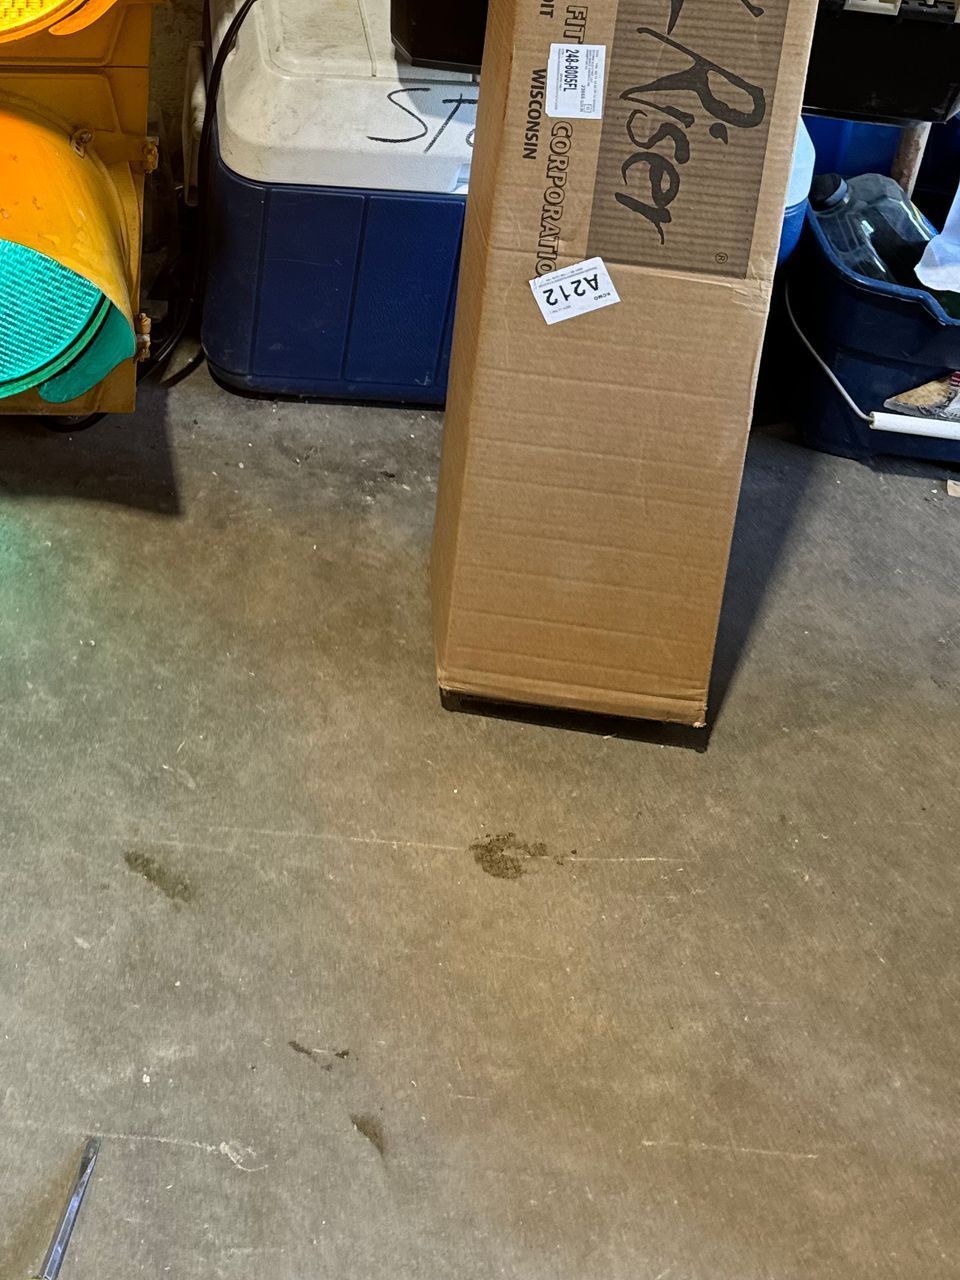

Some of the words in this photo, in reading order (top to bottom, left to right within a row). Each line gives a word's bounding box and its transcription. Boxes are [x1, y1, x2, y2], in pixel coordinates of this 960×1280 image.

[564, 49, 579, 92] 248-8005FL
[522, 68, 547, 160] WISCONSIN
[535, 121, 573, 277] CORPORATIO
[543, 274, 598, 306] A212
